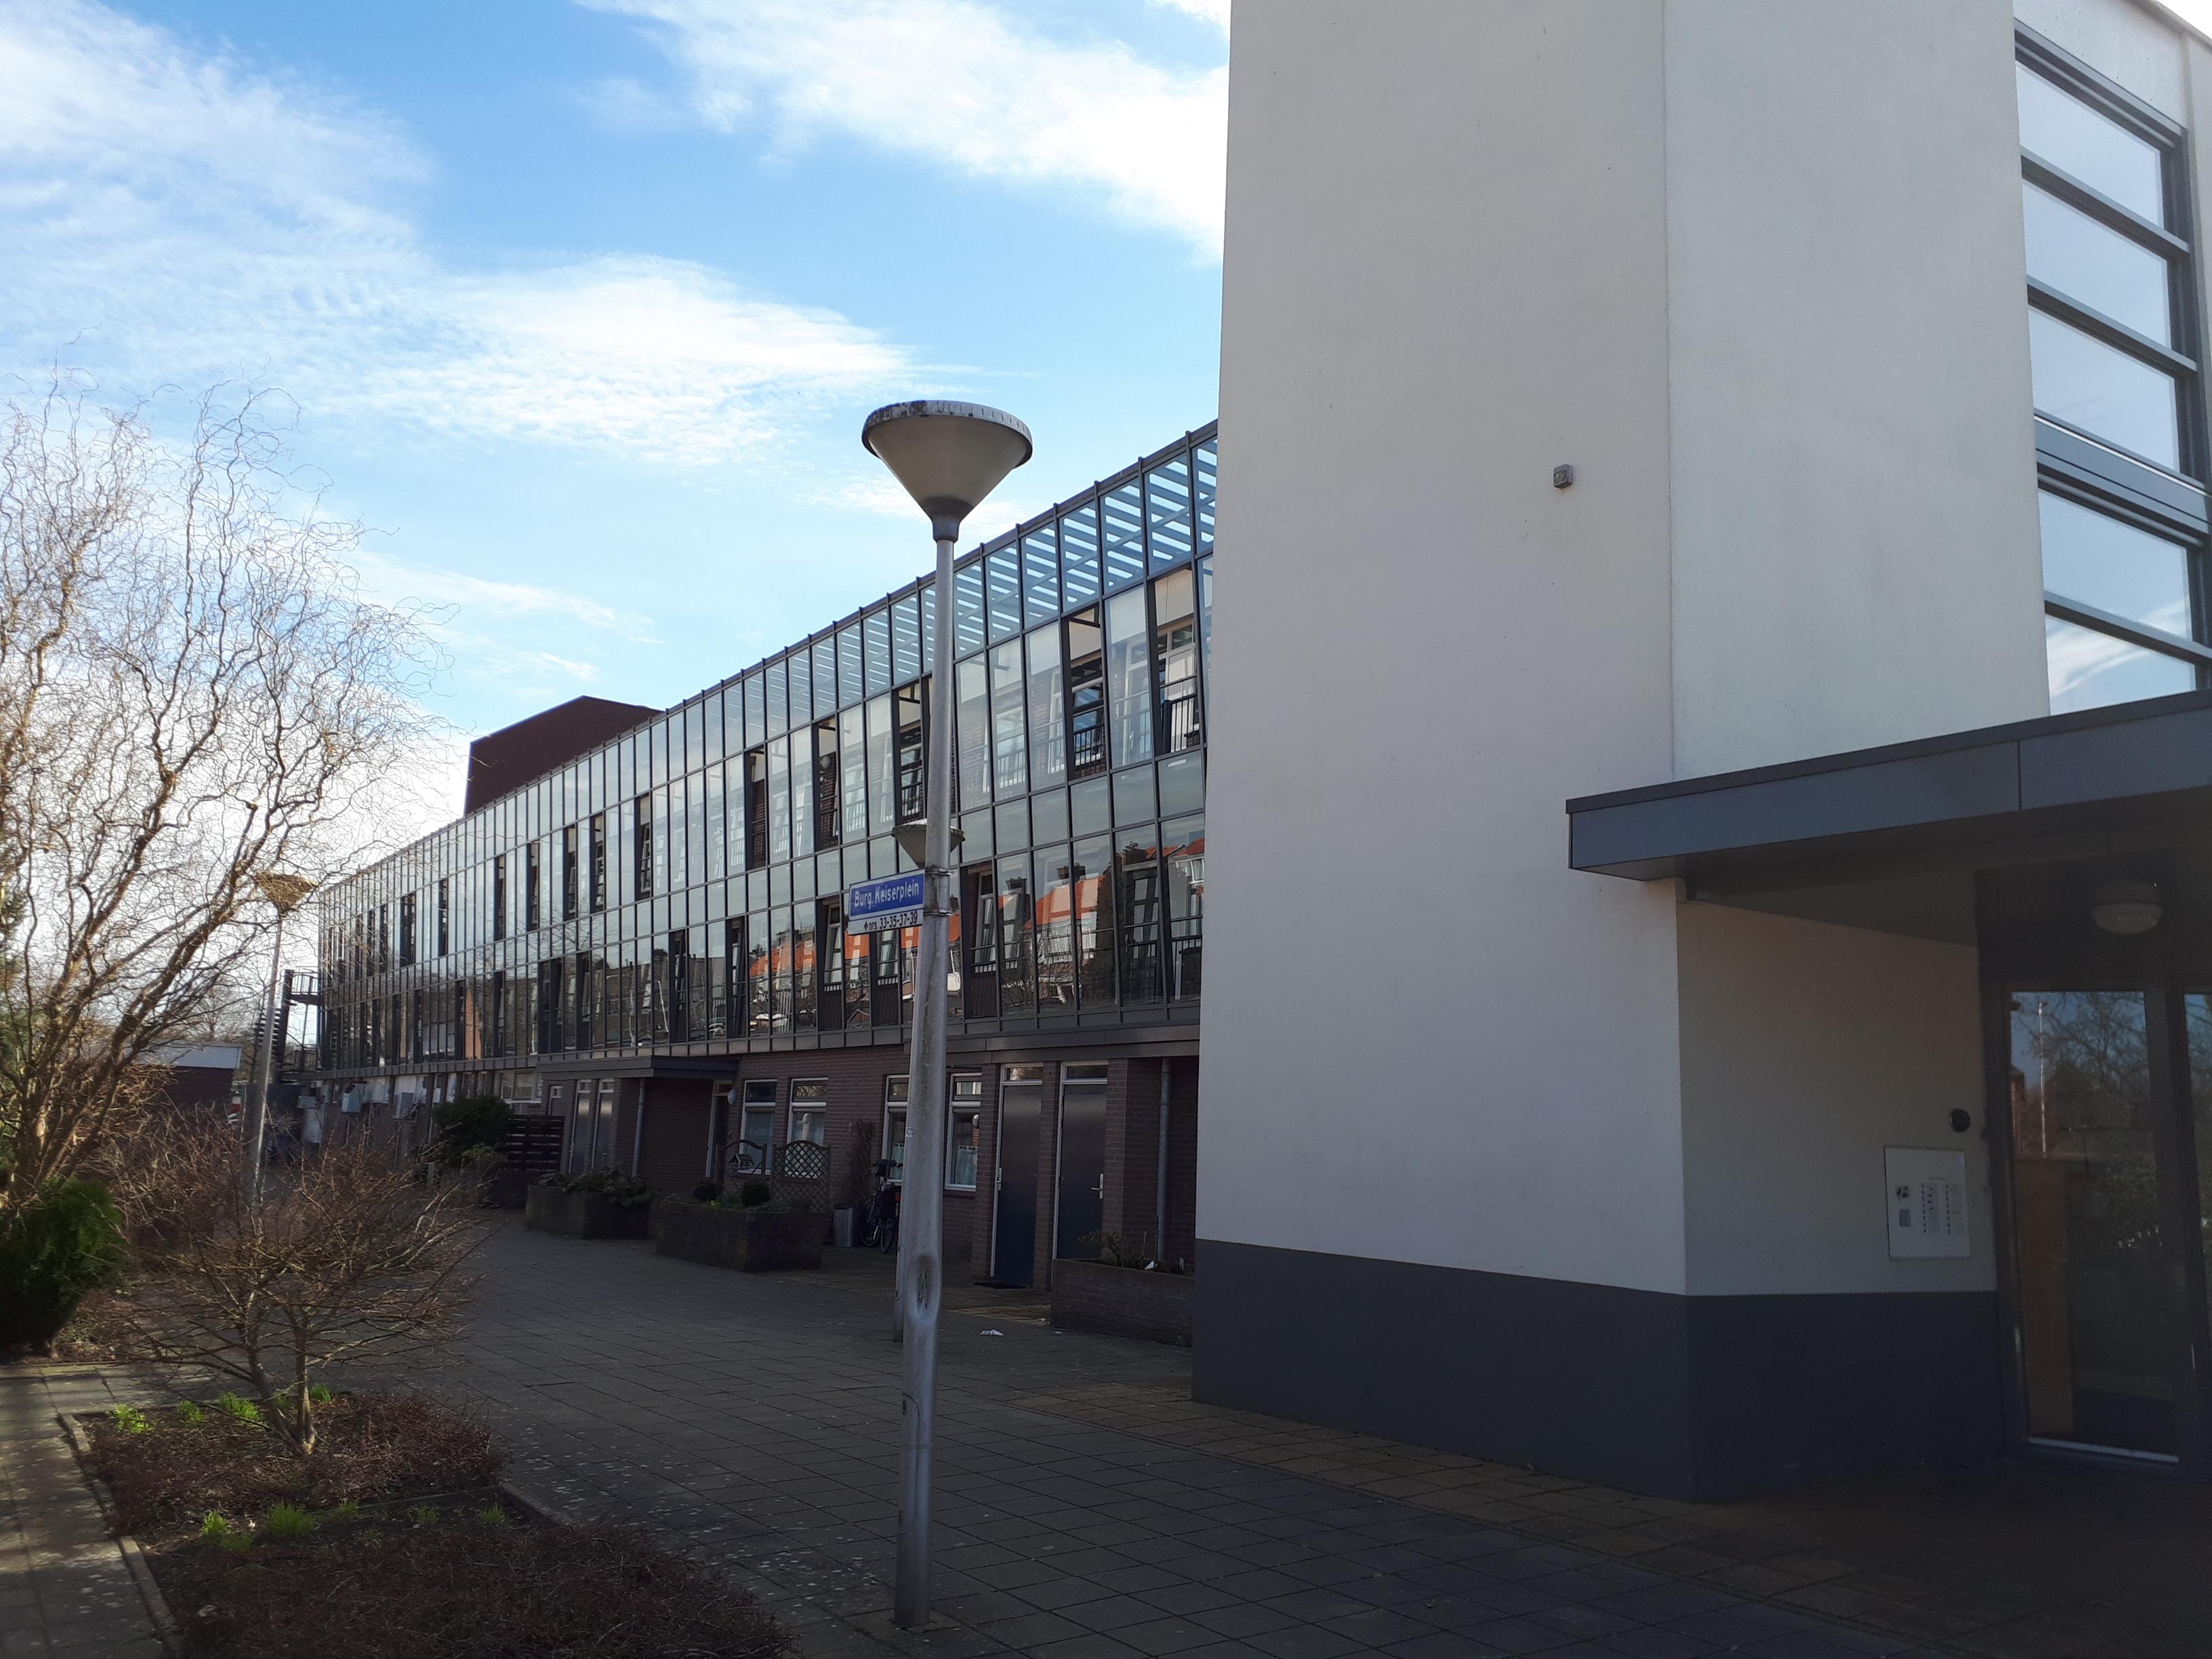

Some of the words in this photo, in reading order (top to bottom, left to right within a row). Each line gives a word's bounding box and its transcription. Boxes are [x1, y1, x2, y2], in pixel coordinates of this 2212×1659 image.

[854, 890, 874, 909] Burg.
[875, 880, 919, 903] Keiserplein
[868, 922, 878, 930] nrs.
[880, 911, 918, 929] 33-35-37-39
